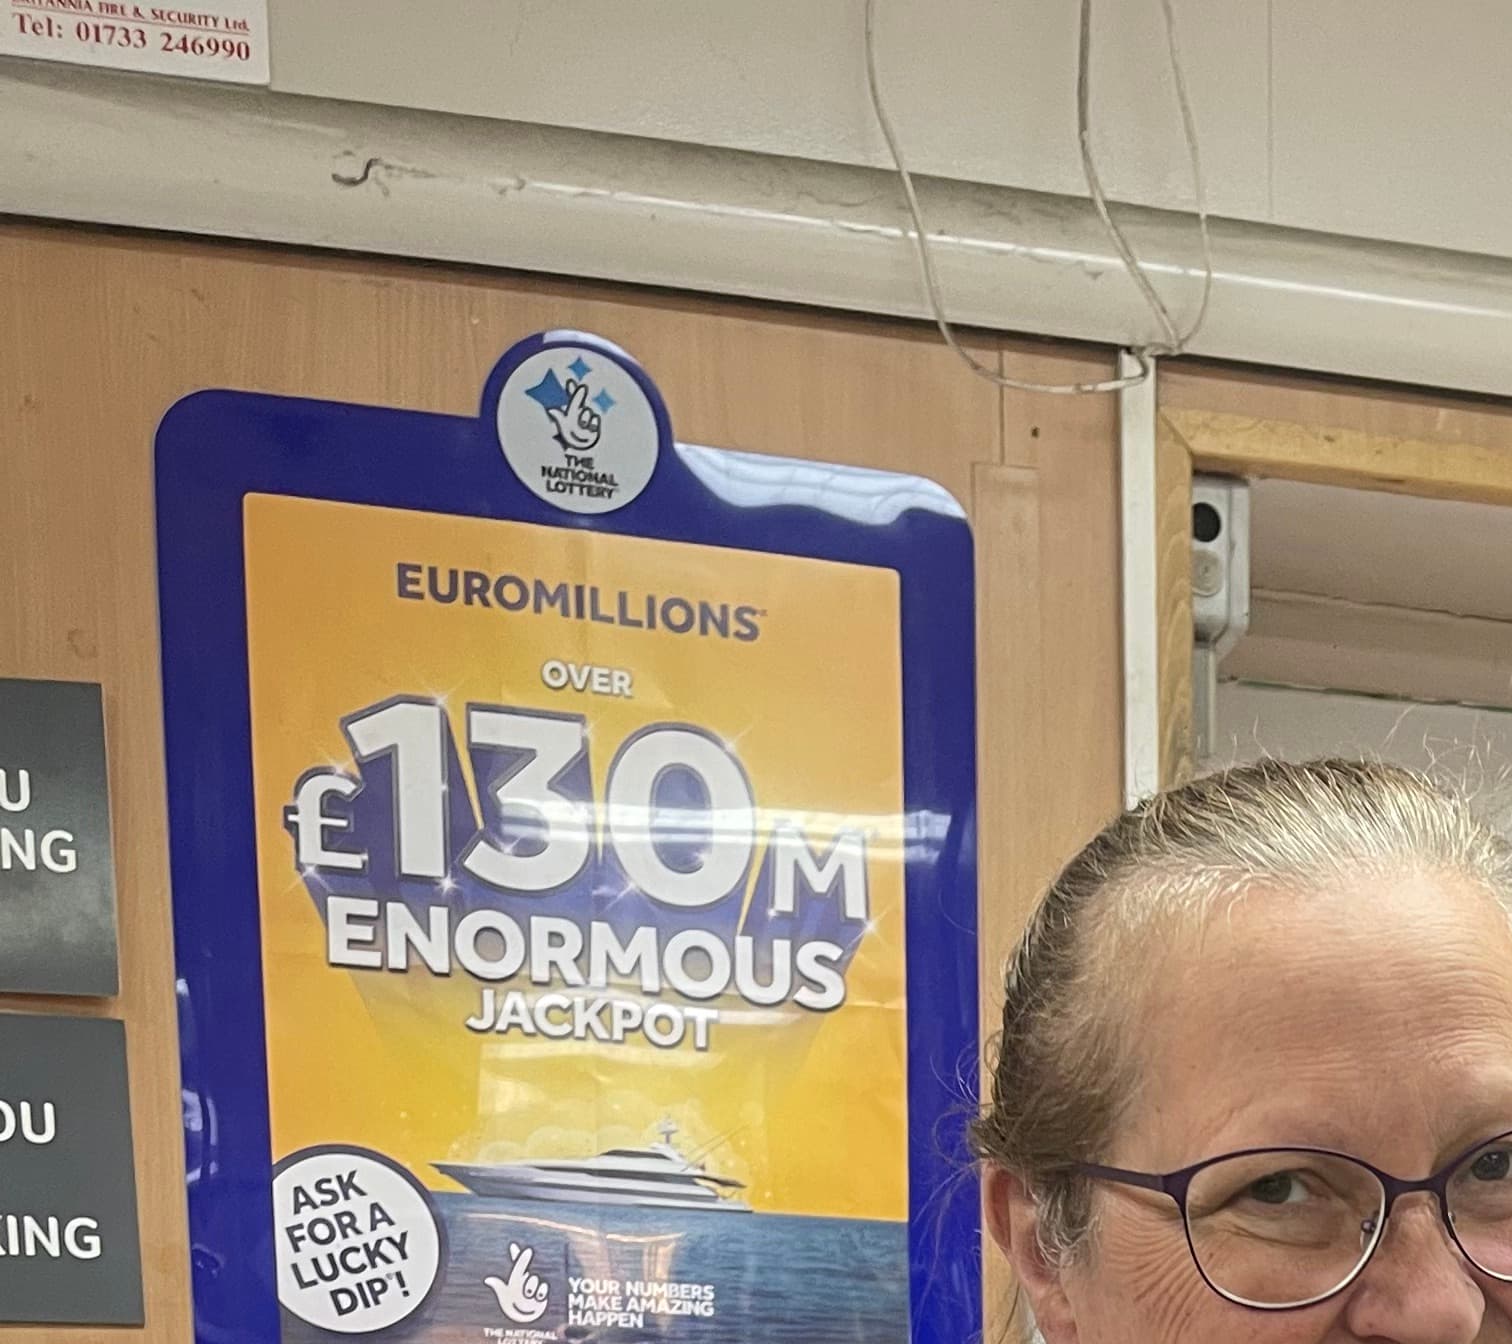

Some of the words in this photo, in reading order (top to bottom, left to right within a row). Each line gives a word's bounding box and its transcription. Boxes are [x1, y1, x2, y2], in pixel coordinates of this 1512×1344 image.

[133, 6, 144, 18] &
[151, 9, 219, 29] SECURITY
[12, 12, 63, 39] Tel:
[76, 21, 147, 49] 01733
[160, 32, 251, 61] 246990
[565, 454, 594, 470] THE
[541, 466, 619, 486] NATIONAL
[546, 480, 616, 499] LOTTERY
[541, 660, 633, 697] OVER
[326, 894, 846, 1010] ENORMOUS
[465, 987, 720, 1051] JACKPOT
[293, 1170, 368, 1215] ASK
[285, 1211, 363, 1253] FOR
[370, 1202, 395, 1232] A
[291, 1231, 408, 1290] LUCKY
[568, 1277, 620, 1295] YOUR
[626, 1281, 714, 1300] NUMBERS
[568, 1294, 622, 1311] MAKE
[627, 1297, 714, 1317] AMAZING
[568, 1310, 643, 1328] HAPPEN
[483, 1327, 504, 1338] THE
